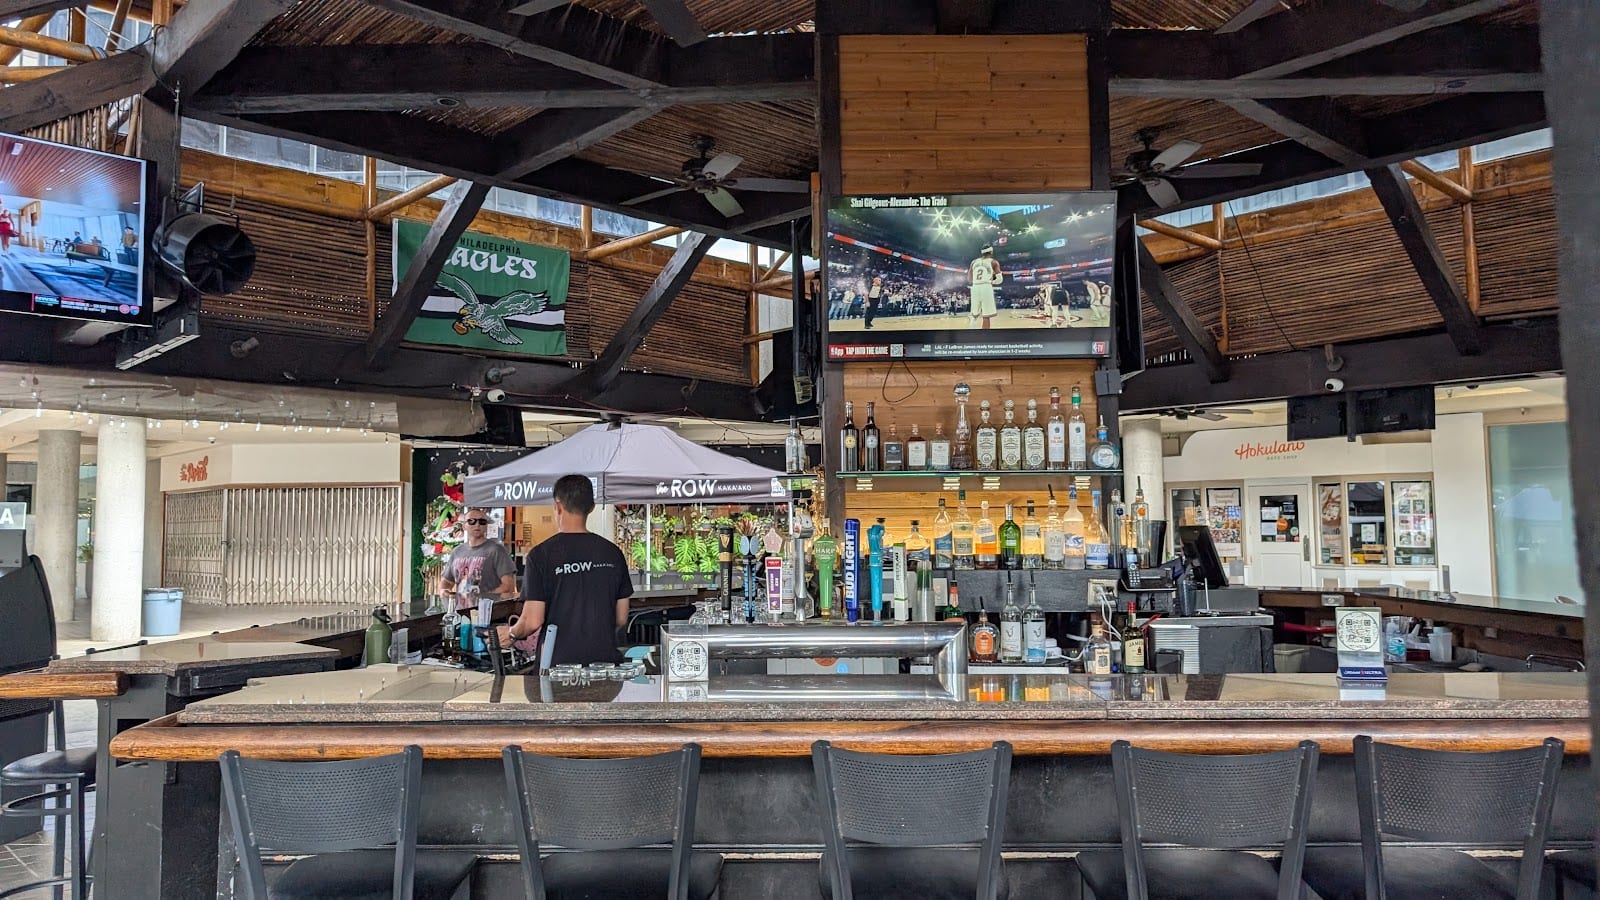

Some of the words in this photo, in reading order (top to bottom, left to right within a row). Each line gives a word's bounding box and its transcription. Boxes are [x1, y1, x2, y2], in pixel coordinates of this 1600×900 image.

[850, 198, 863, 208] Shai
[919, 196, 931, 207] The
[931, 196, 948, 207] Trade
[461, 238, 522, 255] HILADELPHIA
[446, 247, 537, 280] AGLES
[503, 480, 538, 500] ROW
[537, 486, 554, 494] KAKA
[656, 482, 670, 495] the
[670, 479, 718, 498] ROW
[845, 533, 855, 571] LIGHT
[563, 561, 593, 574] ROW
[845, 571, 855, 599] BUD
